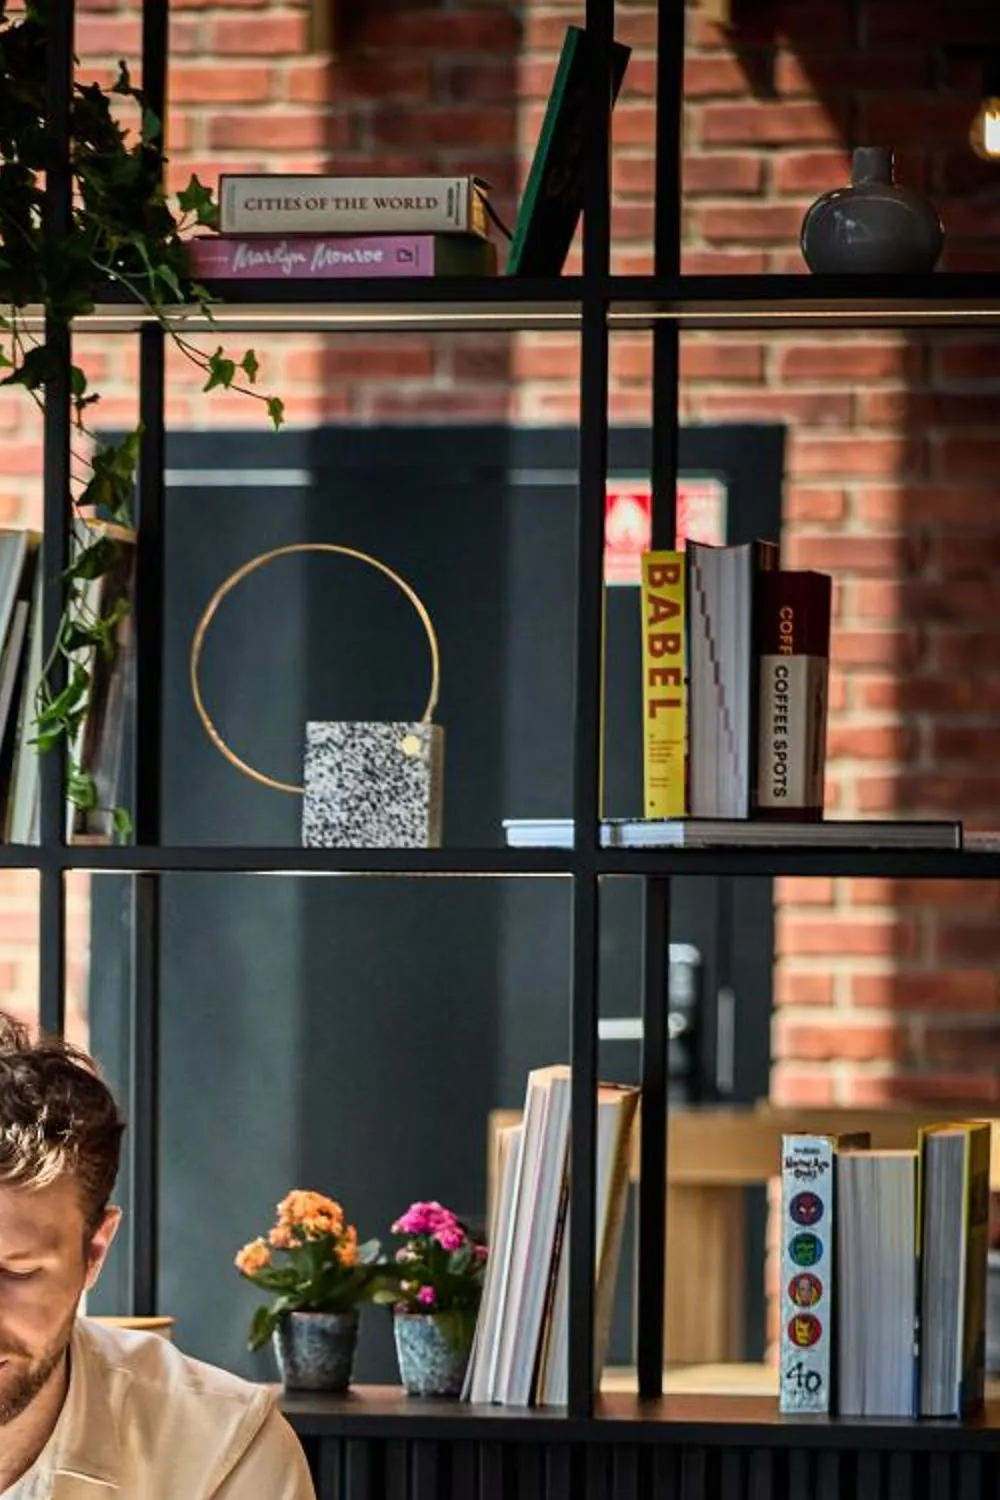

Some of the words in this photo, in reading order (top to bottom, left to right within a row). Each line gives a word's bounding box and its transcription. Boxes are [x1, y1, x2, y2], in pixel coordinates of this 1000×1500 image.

[244, 197, 300, 211] CITIES
[305, 197, 327, 210] OF
[330, 196, 368, 210] THE
[373, 196, 439, 210] WORLD
[310, 243, 384, 272] Monroe
[648, 563, 682, 719] BABEL
[774, 665, 789, 735] COFFEE
[773, 740, 788, 798] SPOTS
